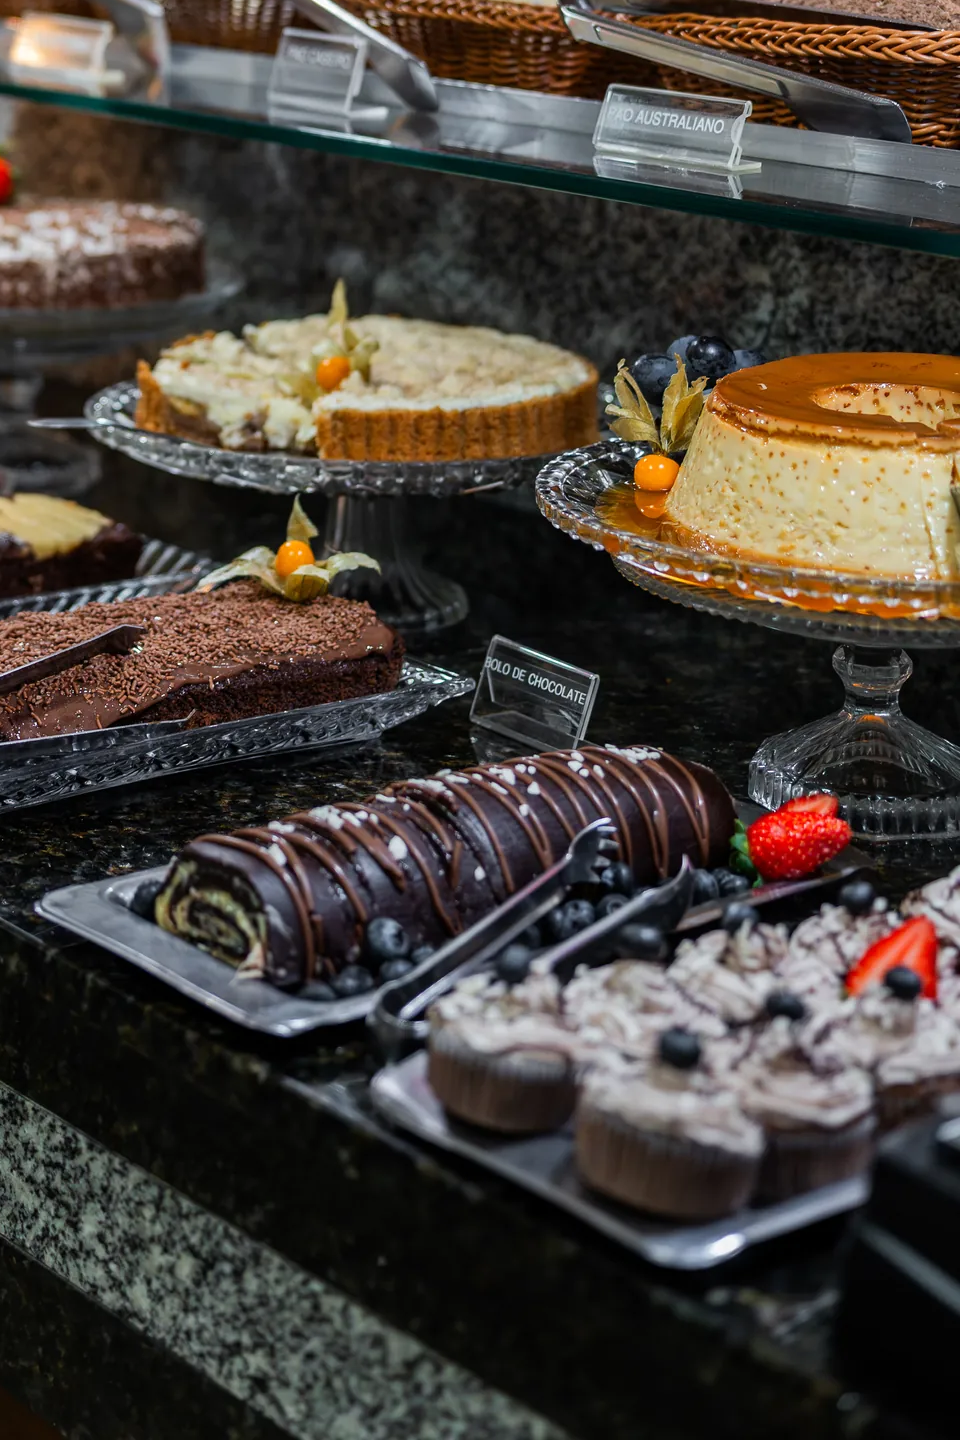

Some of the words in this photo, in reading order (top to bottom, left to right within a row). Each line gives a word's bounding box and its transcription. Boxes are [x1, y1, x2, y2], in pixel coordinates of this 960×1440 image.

[634, 109, 725, 135] AUSTRALIANO
[484, 656, 511, 676] BOLO
[511, 666, 527, 682] DE
[527, 672, 587, 706] CHOCOLATE
